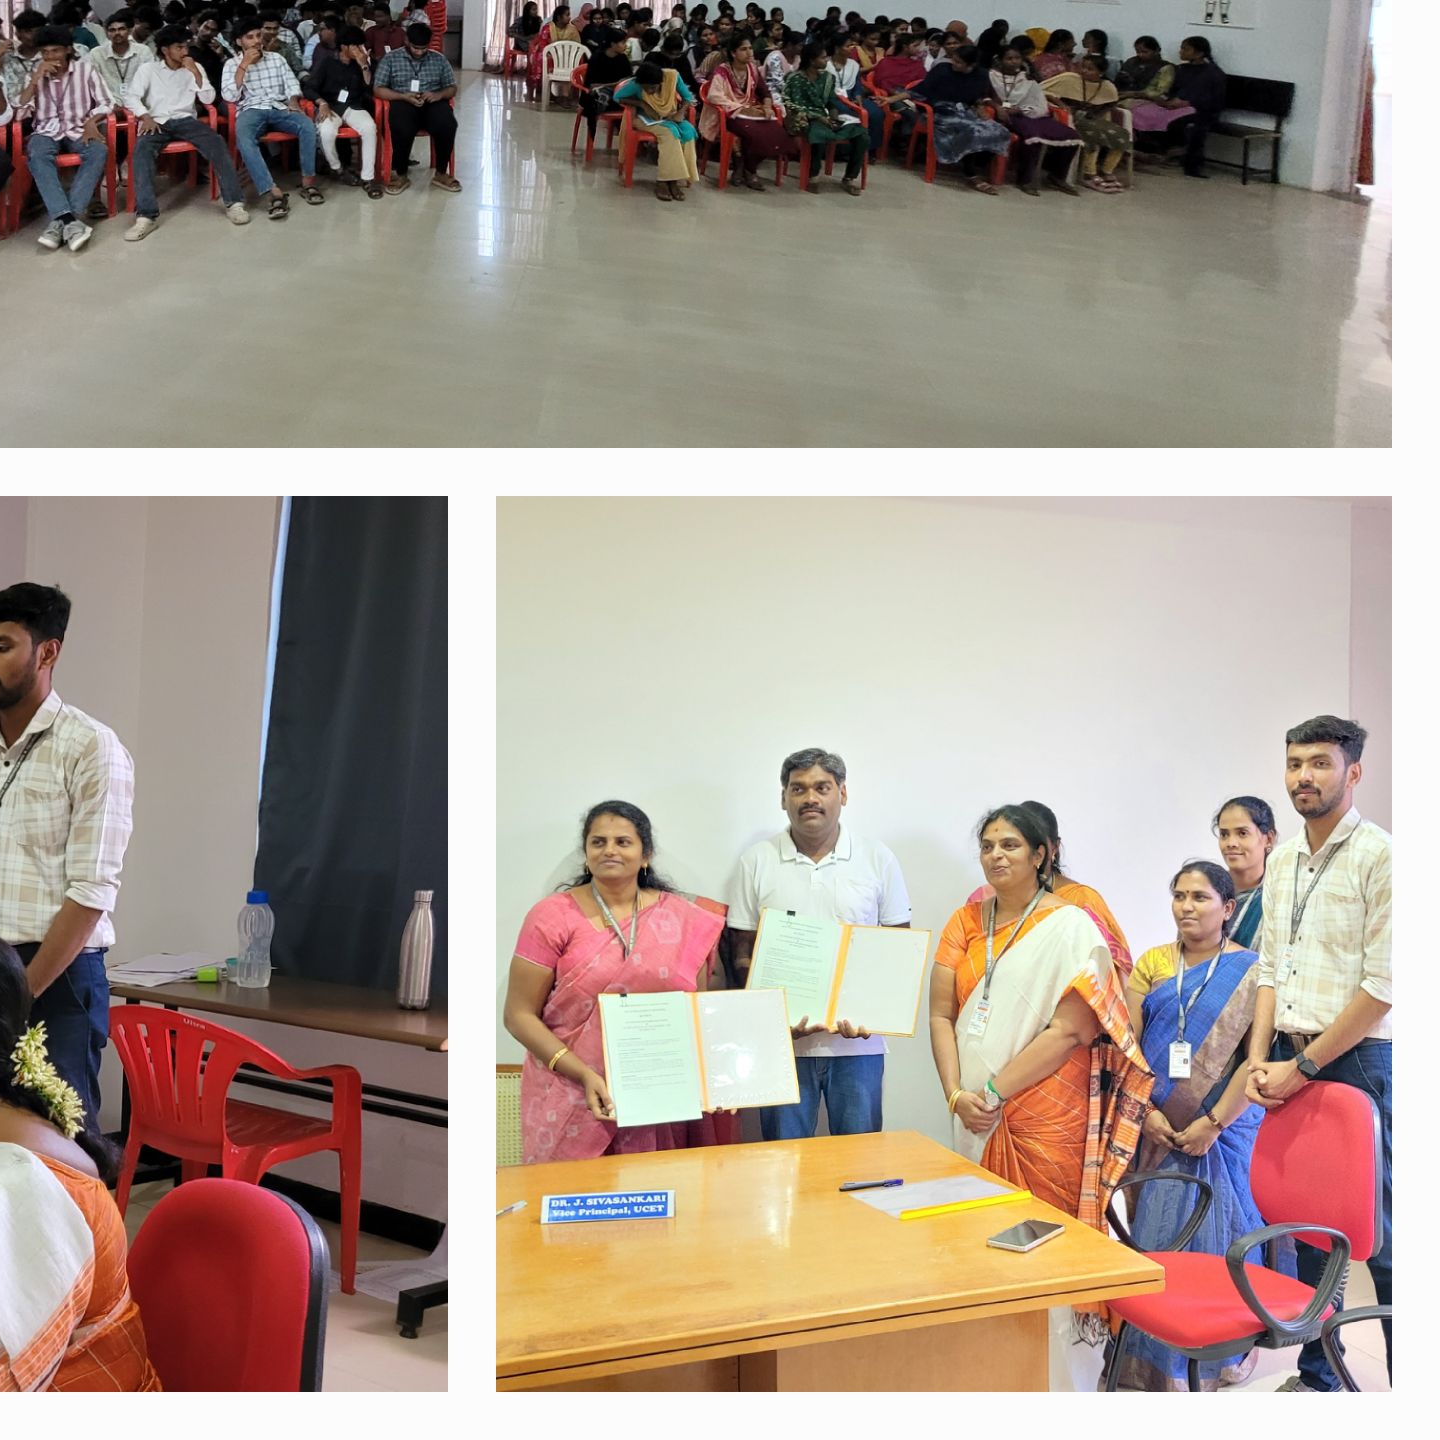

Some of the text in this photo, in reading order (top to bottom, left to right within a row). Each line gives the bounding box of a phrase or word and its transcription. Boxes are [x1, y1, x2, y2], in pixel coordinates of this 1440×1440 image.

[586, 1195, 666, 1205] SIVASANKARI
[579, 1207, 631, 1216] Principal,
[633, 1205, 664, 1213] UCET
